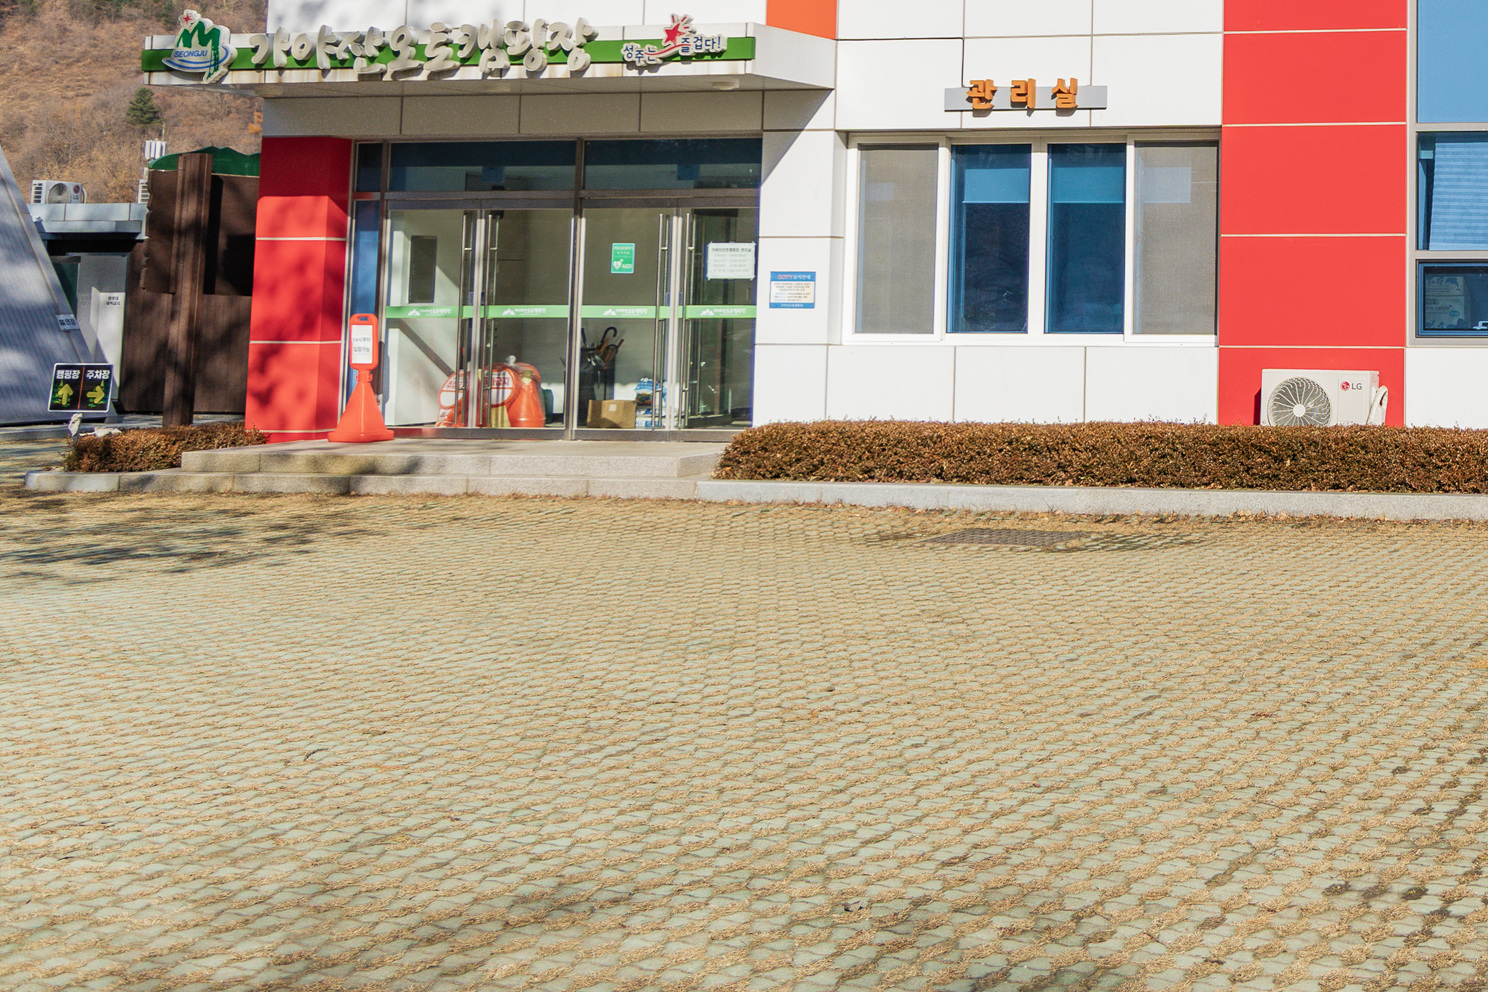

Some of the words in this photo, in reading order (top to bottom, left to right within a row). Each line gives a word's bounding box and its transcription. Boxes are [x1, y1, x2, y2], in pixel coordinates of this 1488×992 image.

[174, 48, 208, 58] SEONGJU
[250, 17, 599, 76] 가야산오토캠핑장
[624, 44, 656, 64] 성주는
[681, 35, 721, 53] 즐겁다!
[966, 78, 1078, 109] 관리실
[56, 370, 81, 379] 캠핑장
[86, 370, 111, 379] 주차장
